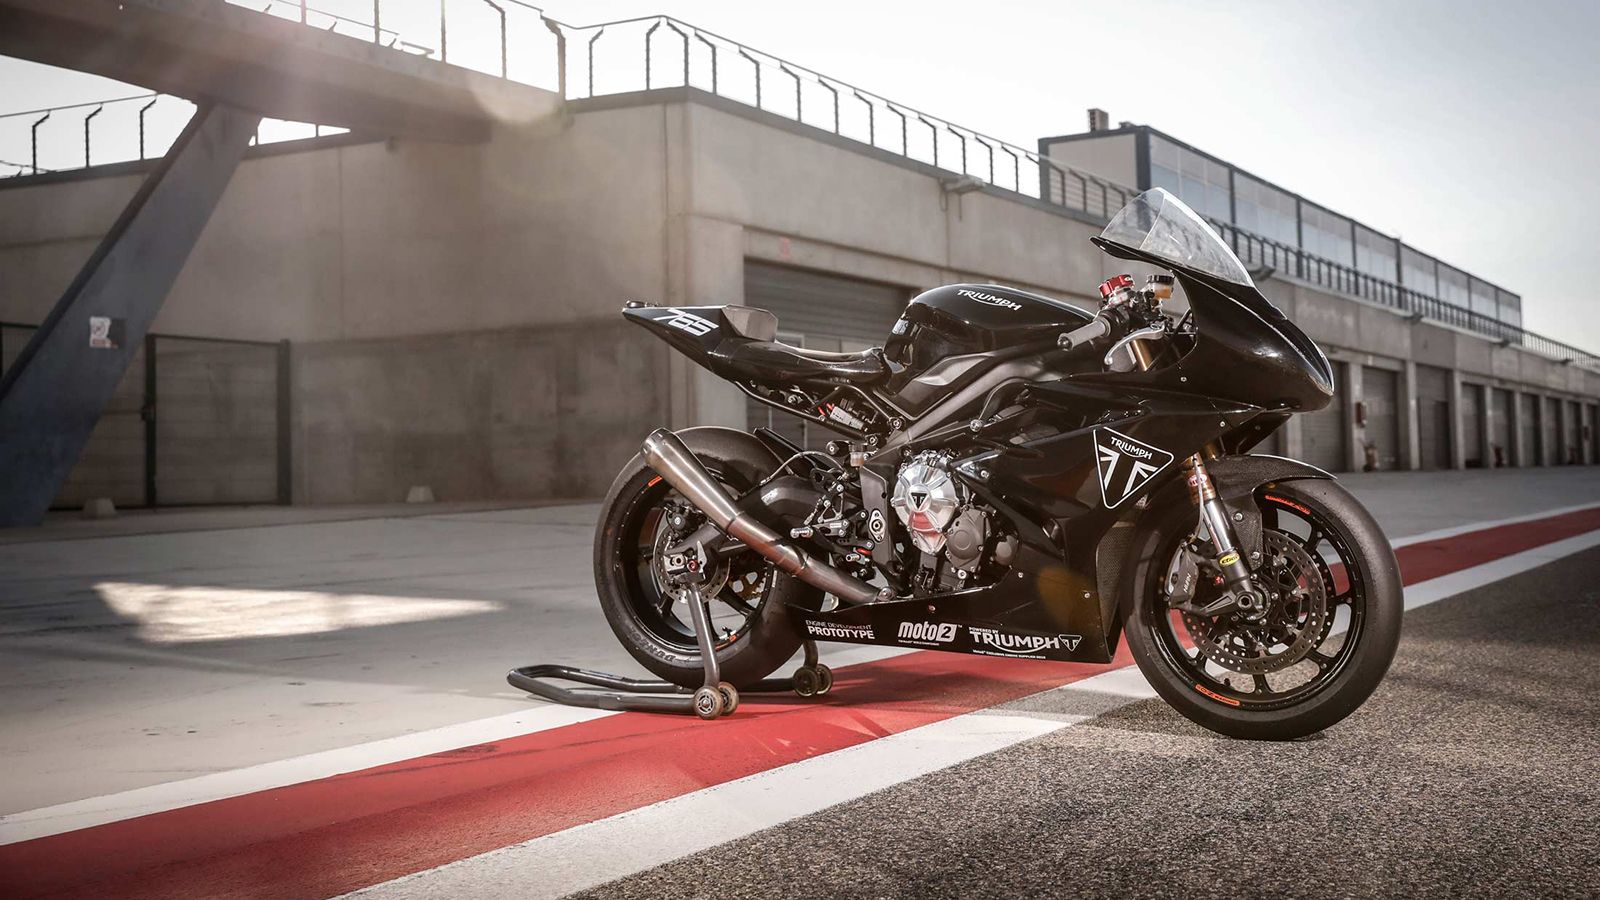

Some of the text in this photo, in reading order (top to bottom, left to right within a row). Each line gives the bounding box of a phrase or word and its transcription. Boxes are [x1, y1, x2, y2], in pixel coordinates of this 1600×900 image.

[957, 289, 1023, 311] TRIUMPH
[652, 307, 720, 337] 765
[1110, 436, 1153, 460] TRIUMPH
[807, 625, 875, 640] PROTOTYPE
[969, 631, 1060, 653] TRIUMPH
